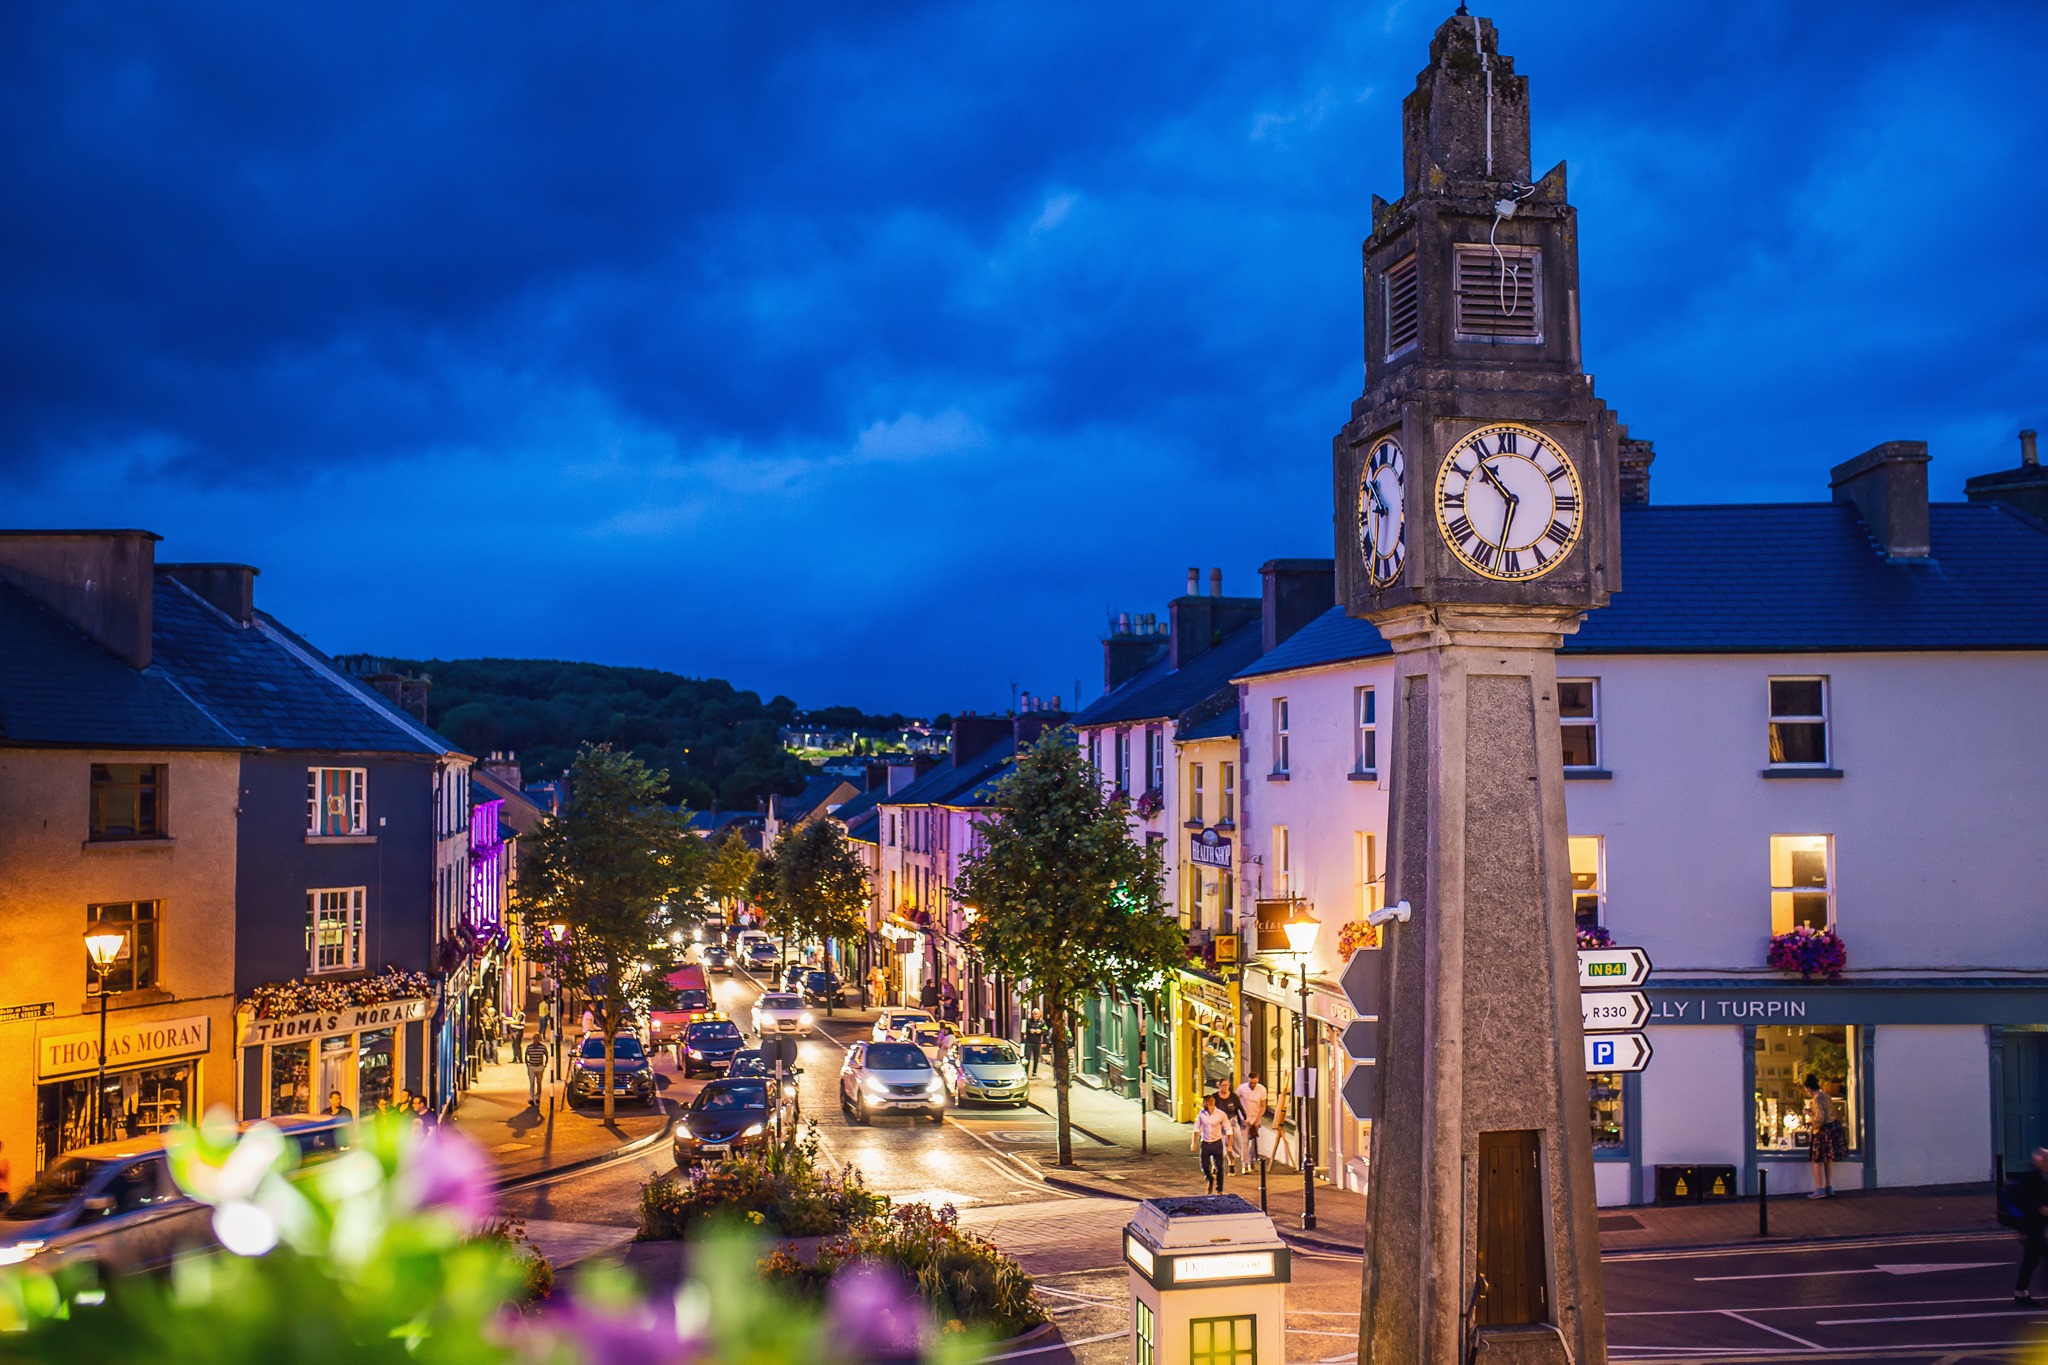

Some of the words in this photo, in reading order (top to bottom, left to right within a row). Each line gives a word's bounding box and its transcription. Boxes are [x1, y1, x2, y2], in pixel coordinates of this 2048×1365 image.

[1497, 433, 1517, 454] XII
[1192, 840, 1215, 863] HEALTH
[1215, 844, 1231, 866] SHOP
[21, 1010, 41, 1019] STREET
[1717, 1001, 1806, 1017] TURPIN
[258, 1016, 338, 1040] THOMAS
[355, 1004, 417, 1026] MORAN
[137, 1025, 202, 1053] MORAN
[1598, 1043, 1611, 1063] P
